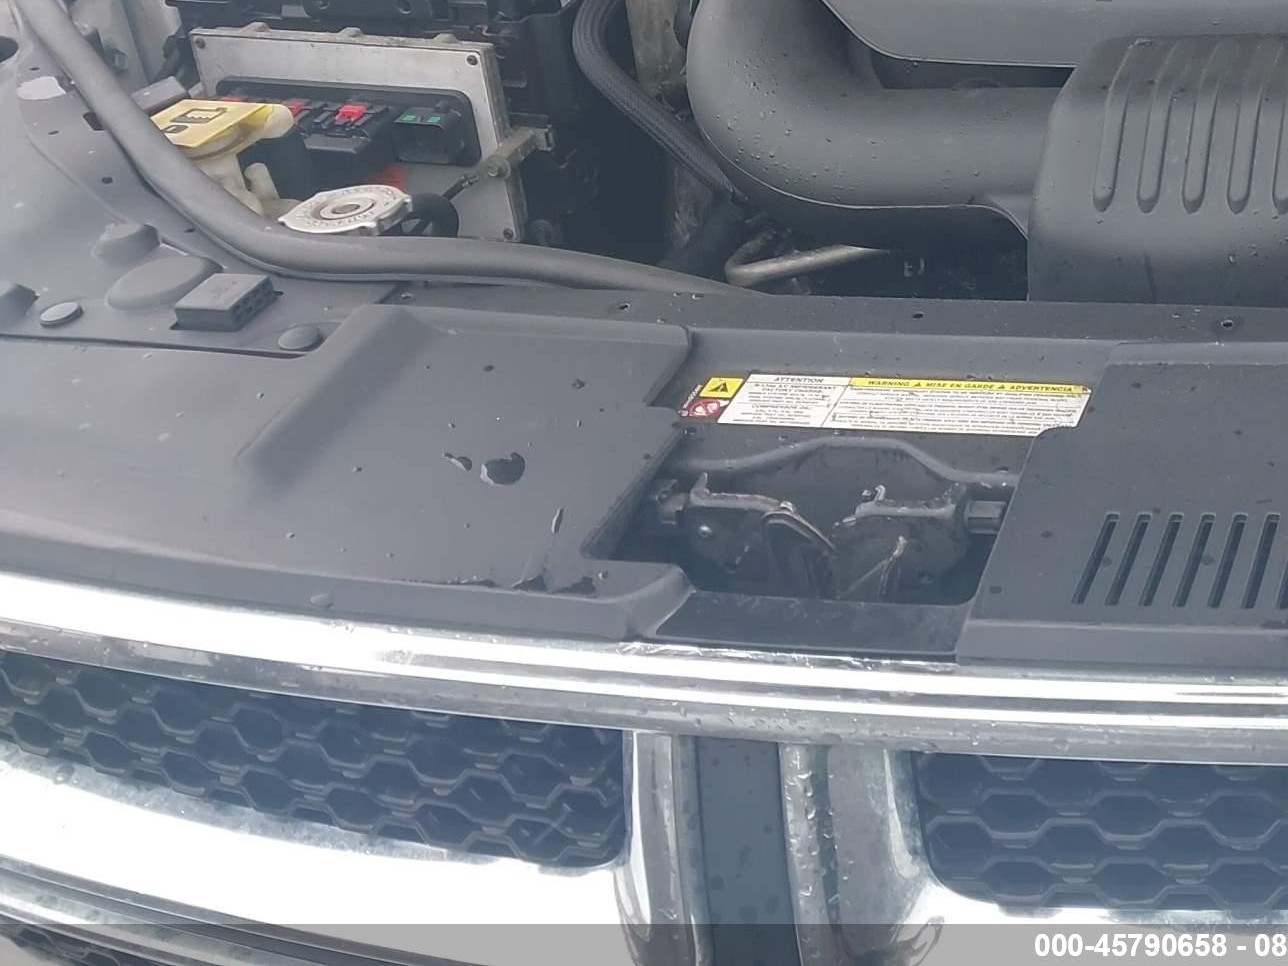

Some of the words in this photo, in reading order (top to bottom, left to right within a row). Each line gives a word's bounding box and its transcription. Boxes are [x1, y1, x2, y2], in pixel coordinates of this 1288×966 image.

[774, 376, 824, 384] ATTENTION
[867, 380, 911, 388] WARNING
[926, 381, 948, 389] MISE
[964, 382, 996, 390] GARDE
[1009, 384, 1073, 392] ADVERTENCIA
